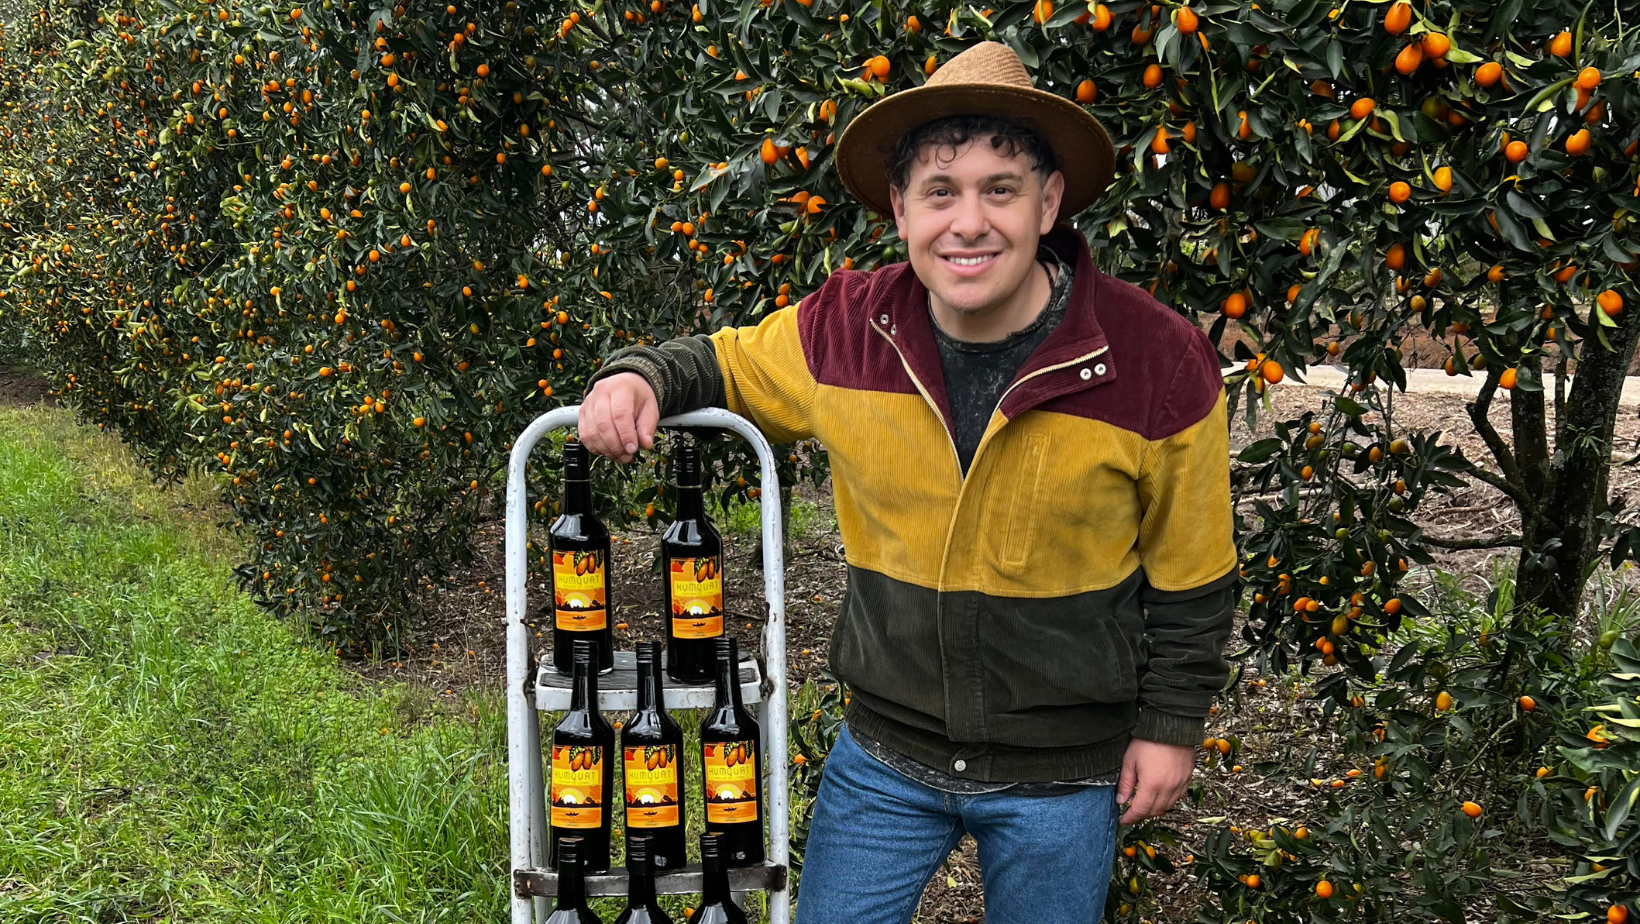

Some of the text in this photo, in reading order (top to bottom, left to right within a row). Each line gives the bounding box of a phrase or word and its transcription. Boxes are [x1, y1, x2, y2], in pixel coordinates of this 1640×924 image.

[558, 575, 600, 585] KUMQUAT
[676, 581, 719, 591] KUMQUAT
[555, 771, 596, 780] KUMQUAT
[629, 770, 672, 780] KUMQUAT
[709, 766, 750, 776] KUMQUAT
